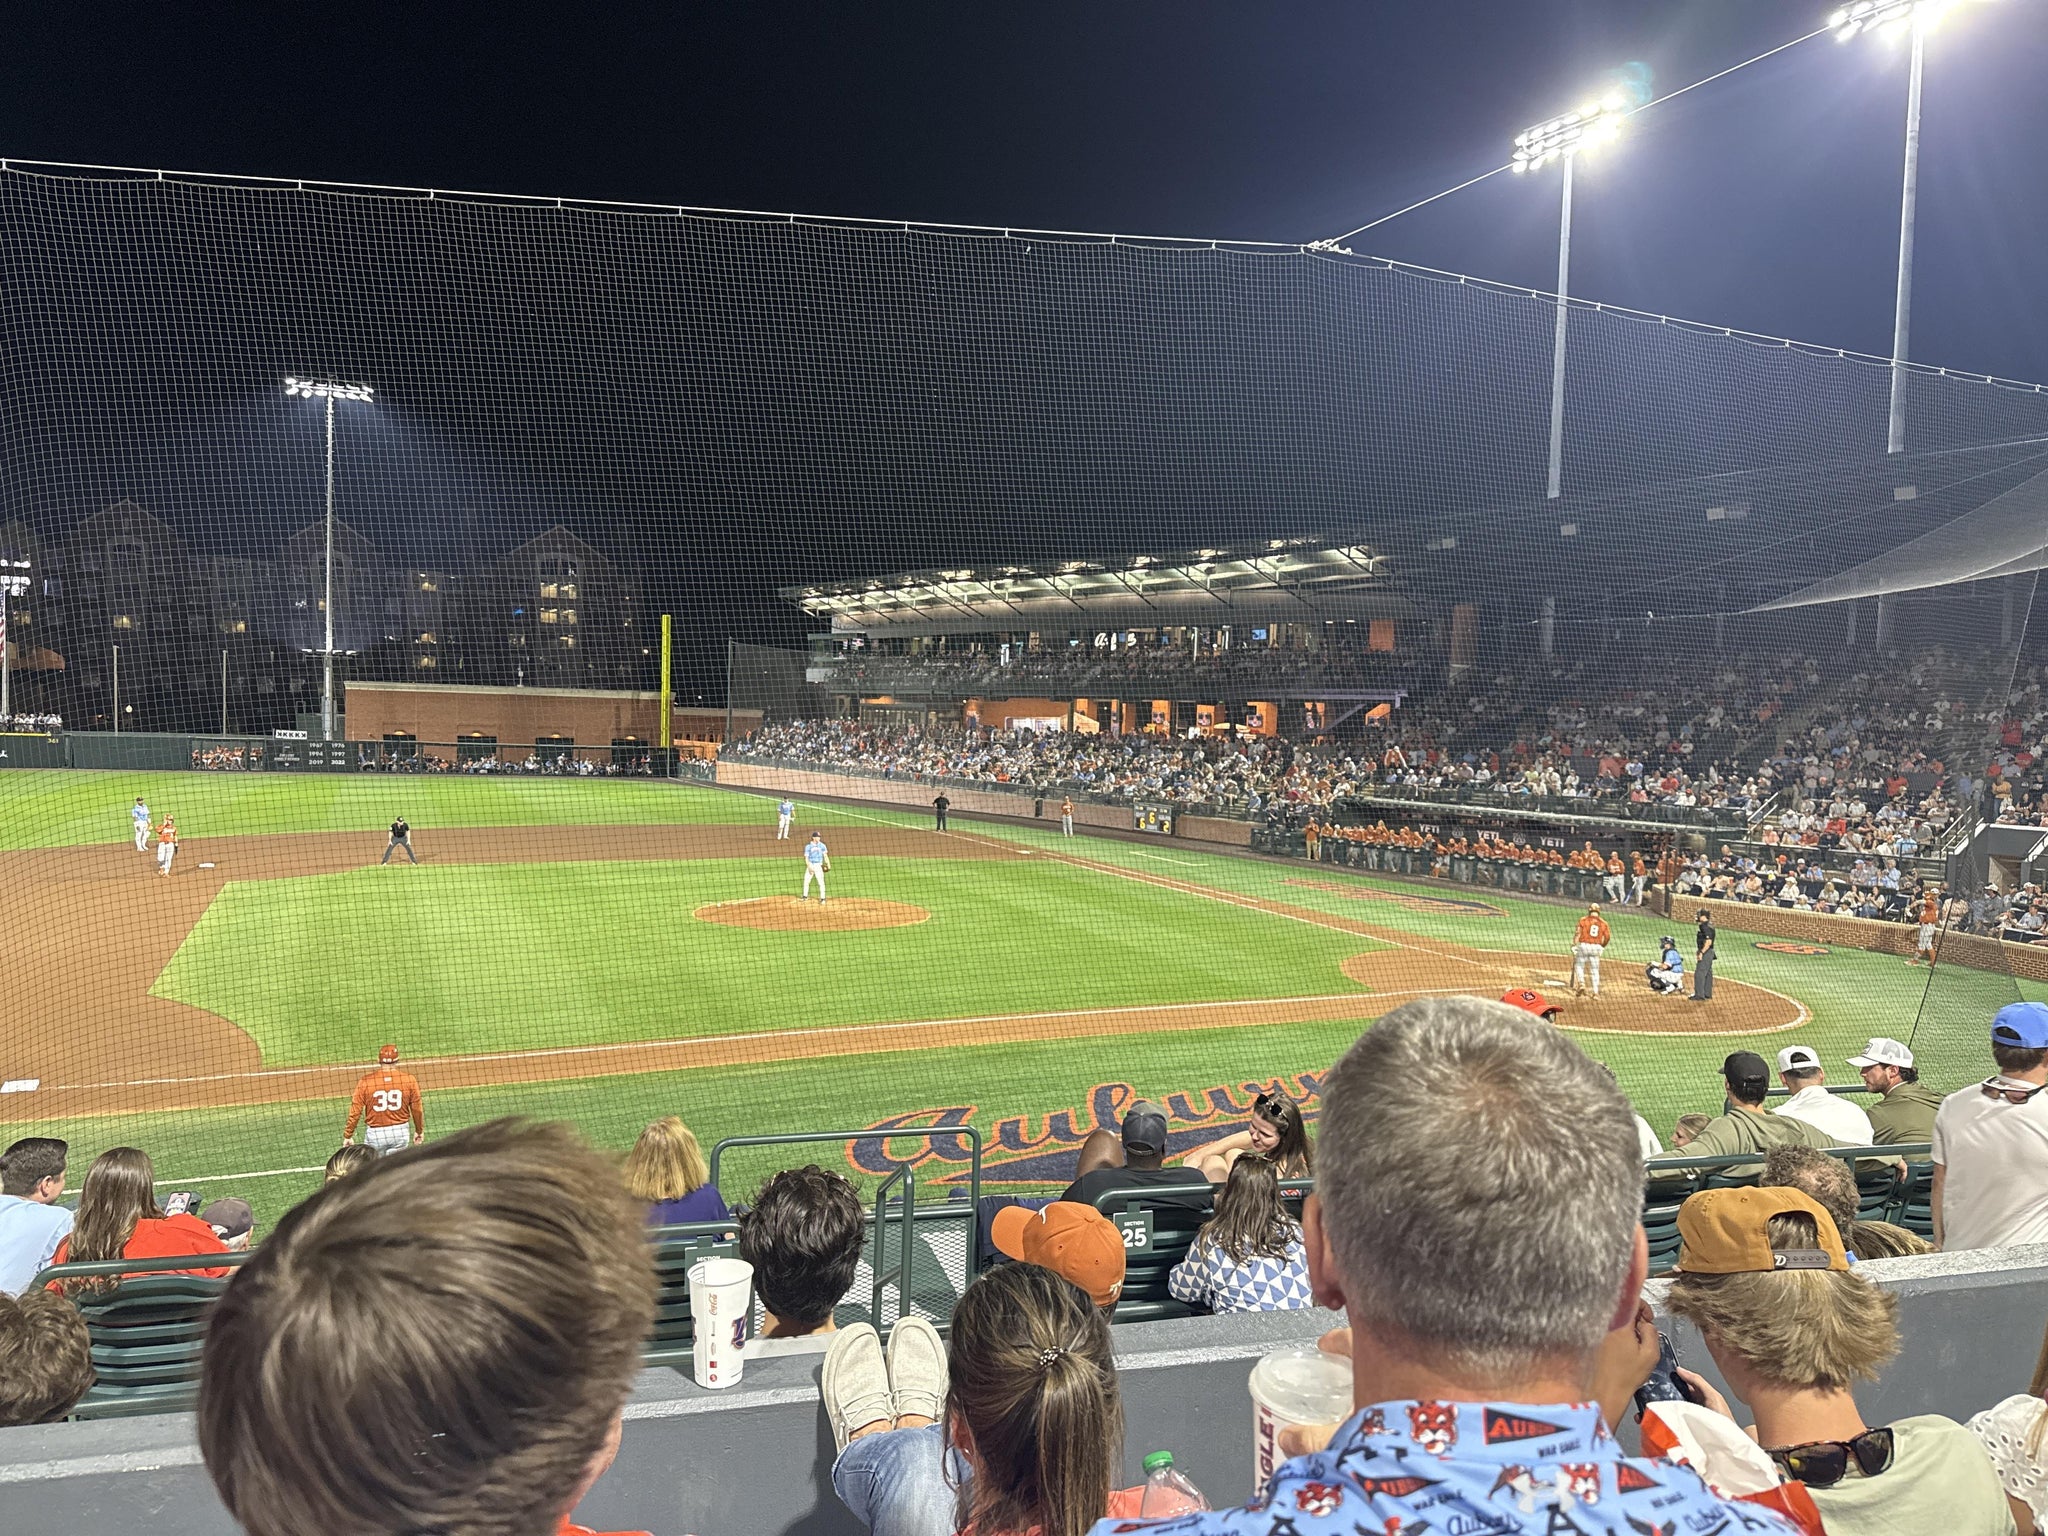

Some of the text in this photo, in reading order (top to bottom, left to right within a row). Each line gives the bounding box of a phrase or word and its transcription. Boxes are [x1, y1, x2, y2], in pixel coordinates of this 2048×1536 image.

[1419, 823, 1440, 834] YETI
[1476, 829, 1500, 840] YETI
[1540, 836, 1564, 848] YETI
[1590, 924, 1599, 937] 8
[372, 1089, 403, 1112] 39
[1121, 1227, 1147, 1248] 25
